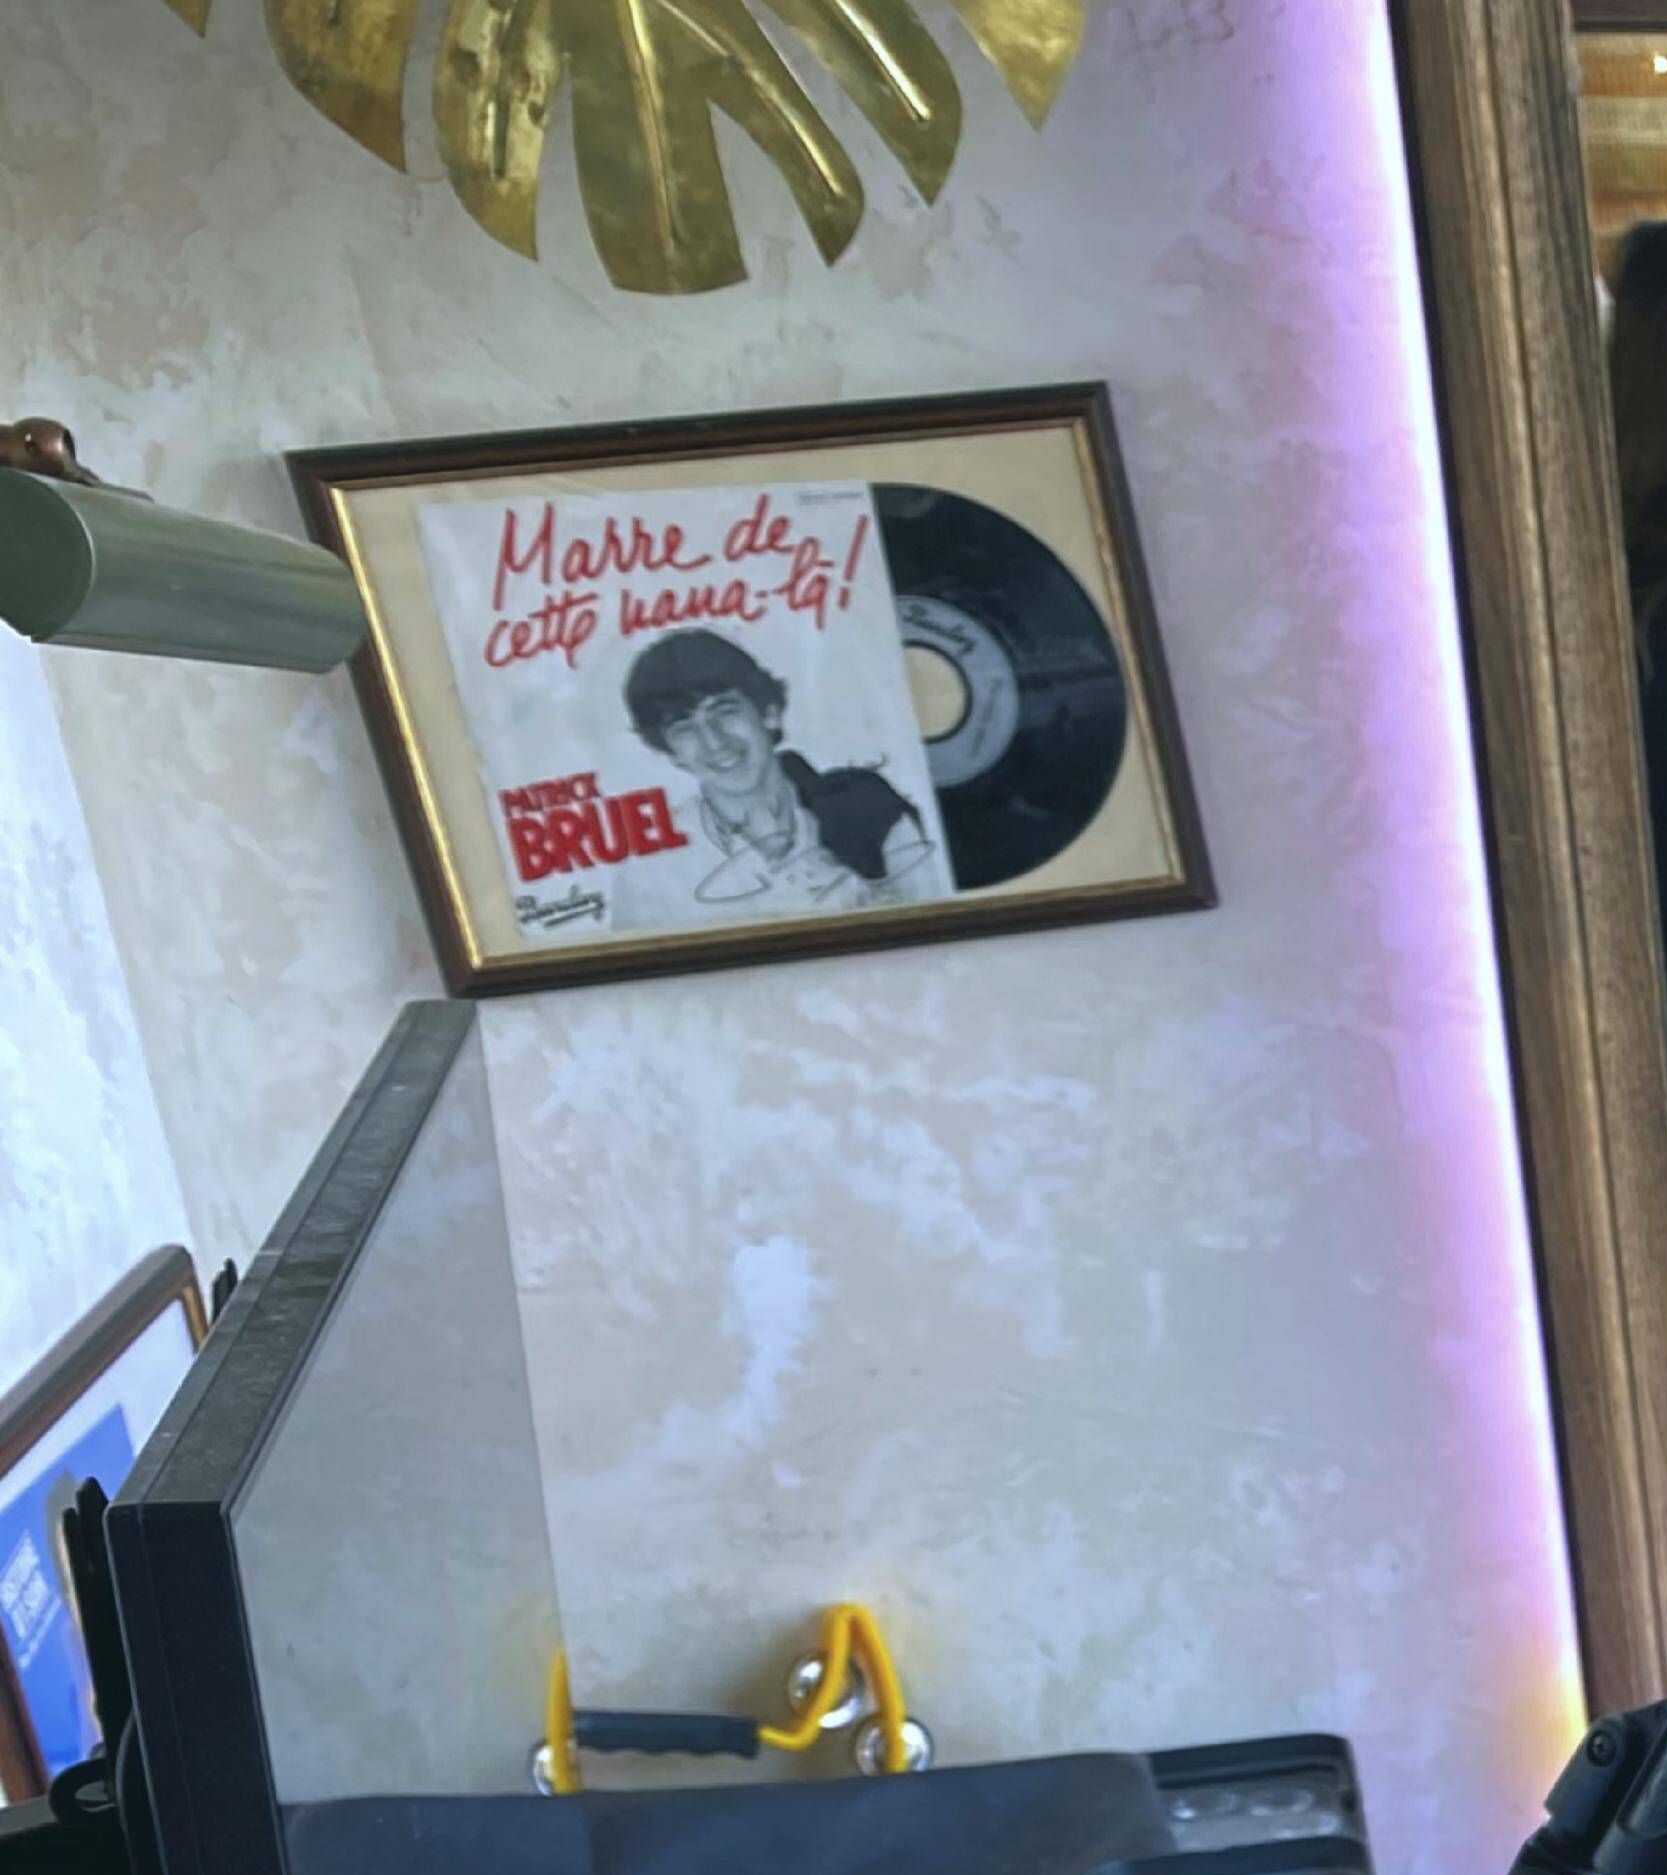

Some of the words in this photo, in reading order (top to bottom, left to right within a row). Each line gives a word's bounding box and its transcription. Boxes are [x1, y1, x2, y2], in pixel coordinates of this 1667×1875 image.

[493, 501, 713, 610] Marre
[723, 494, 793, 560] de
[485, 593, 597, 669] cette
[498, 771, 601, 818] PATRICK
[508, 787, 691, 882] BRUEL
